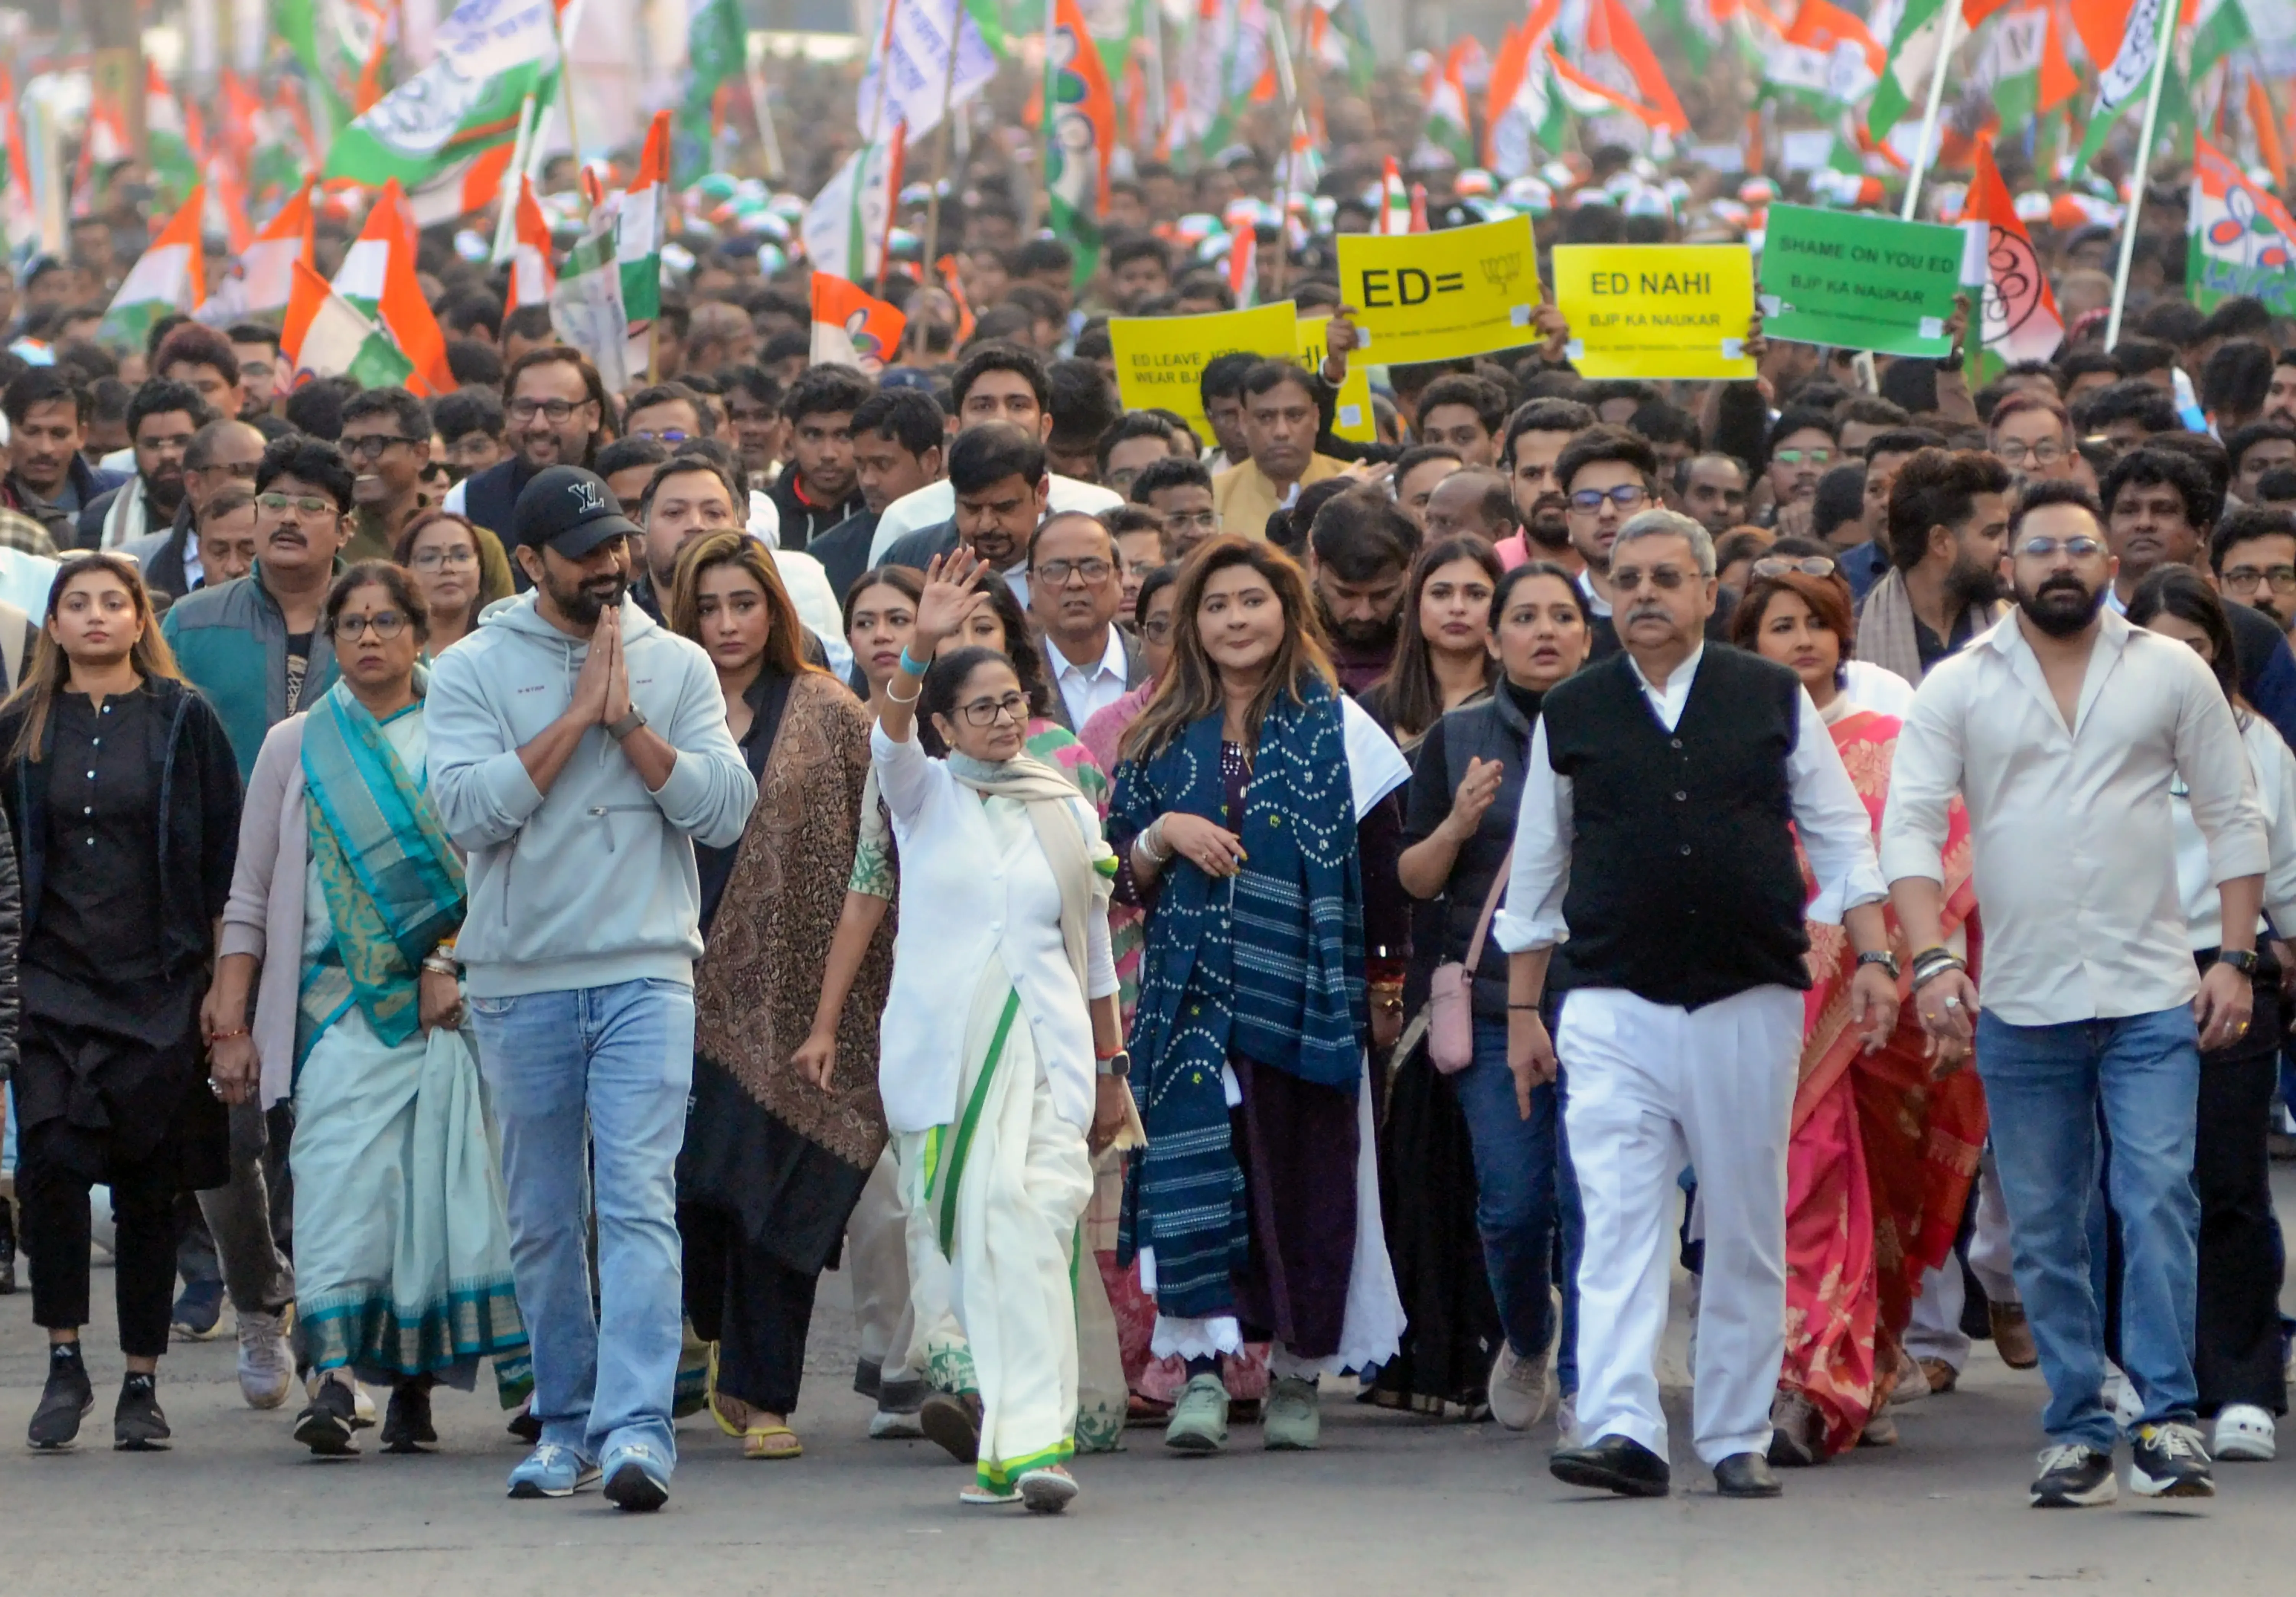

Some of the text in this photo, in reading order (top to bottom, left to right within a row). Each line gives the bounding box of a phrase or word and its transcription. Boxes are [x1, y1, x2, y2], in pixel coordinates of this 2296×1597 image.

[1779, 235, 1955, 273] SHAME ON YOU ED
[1591, 272, 1711, 295] ED NAHI
[1790, 275, 1822, 290] BJP
[1826, 280, 1849, 295] KA
[1589, 314, 1720, 327] BJP KA NAUKAR
[1132, 353, 1150, 366] ED
[1155, 352, 1201, 366] LEAVE
[1135, 371, 1202, 384] WEAR BJ
